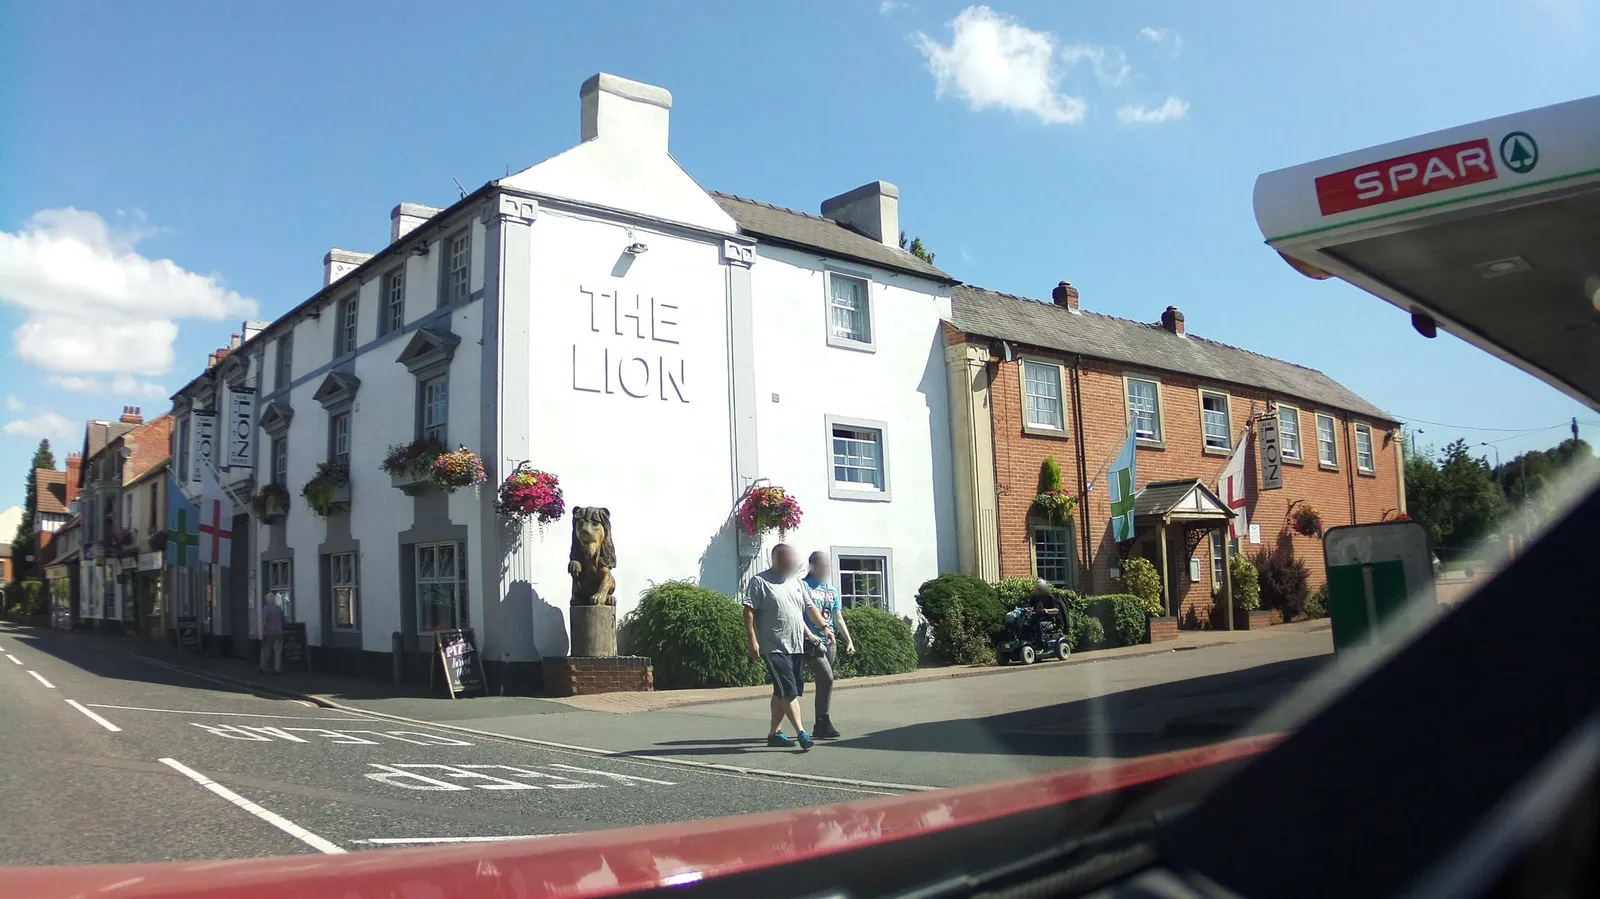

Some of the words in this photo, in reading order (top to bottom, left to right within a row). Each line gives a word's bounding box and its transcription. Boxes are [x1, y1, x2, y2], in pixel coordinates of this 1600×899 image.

[1353, 147, 1490, 200] SPAR
[579, 284, 680, 344] THE
[573, 344, 690, 403] LION
[237, 401, 250, 457] LION
[1265, 427, 1278, 479] LION
[445, 642, 475, 658] PIZZA
[189, 722, 475, 746] CLEAR
[363, 763, 678, 791] KEEP
